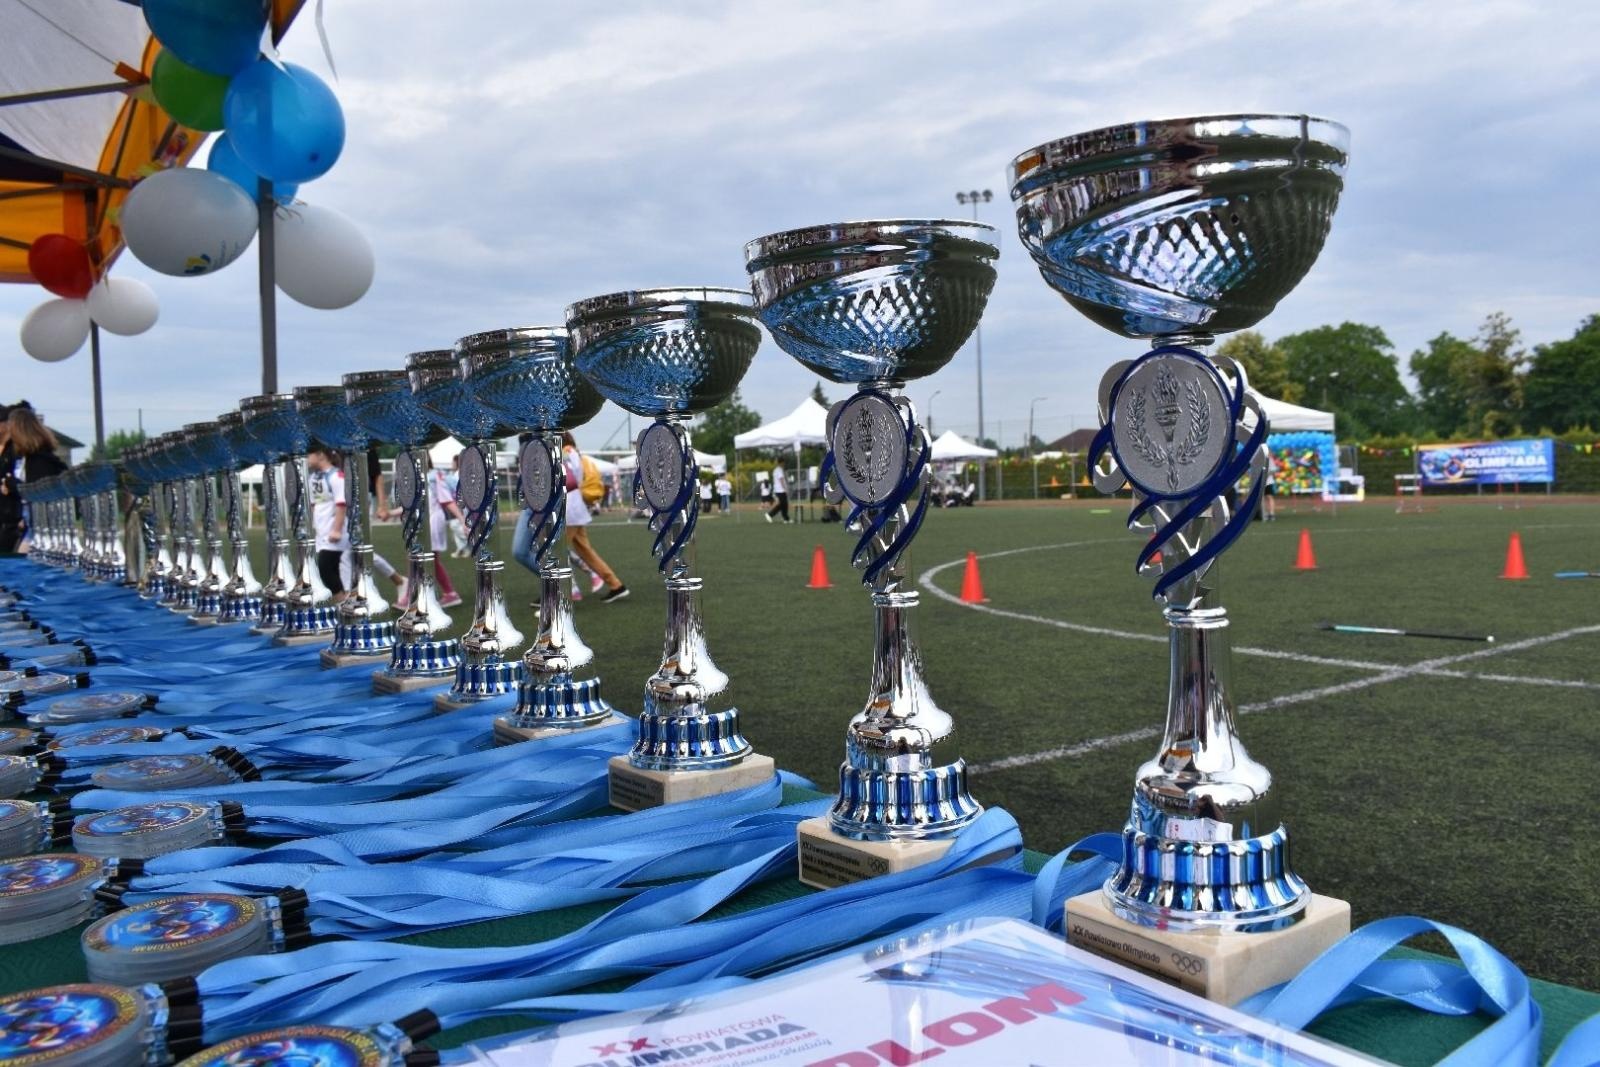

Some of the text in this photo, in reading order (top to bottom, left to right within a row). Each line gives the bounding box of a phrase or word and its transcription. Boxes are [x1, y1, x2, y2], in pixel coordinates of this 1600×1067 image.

[1463, 455, 1547, 469] OLIMPIADA
[1073, 924, 1161, 964] XX Powiatowa Olimpiada
[589, 1013, 786, 1057] XX POWIATOWA
